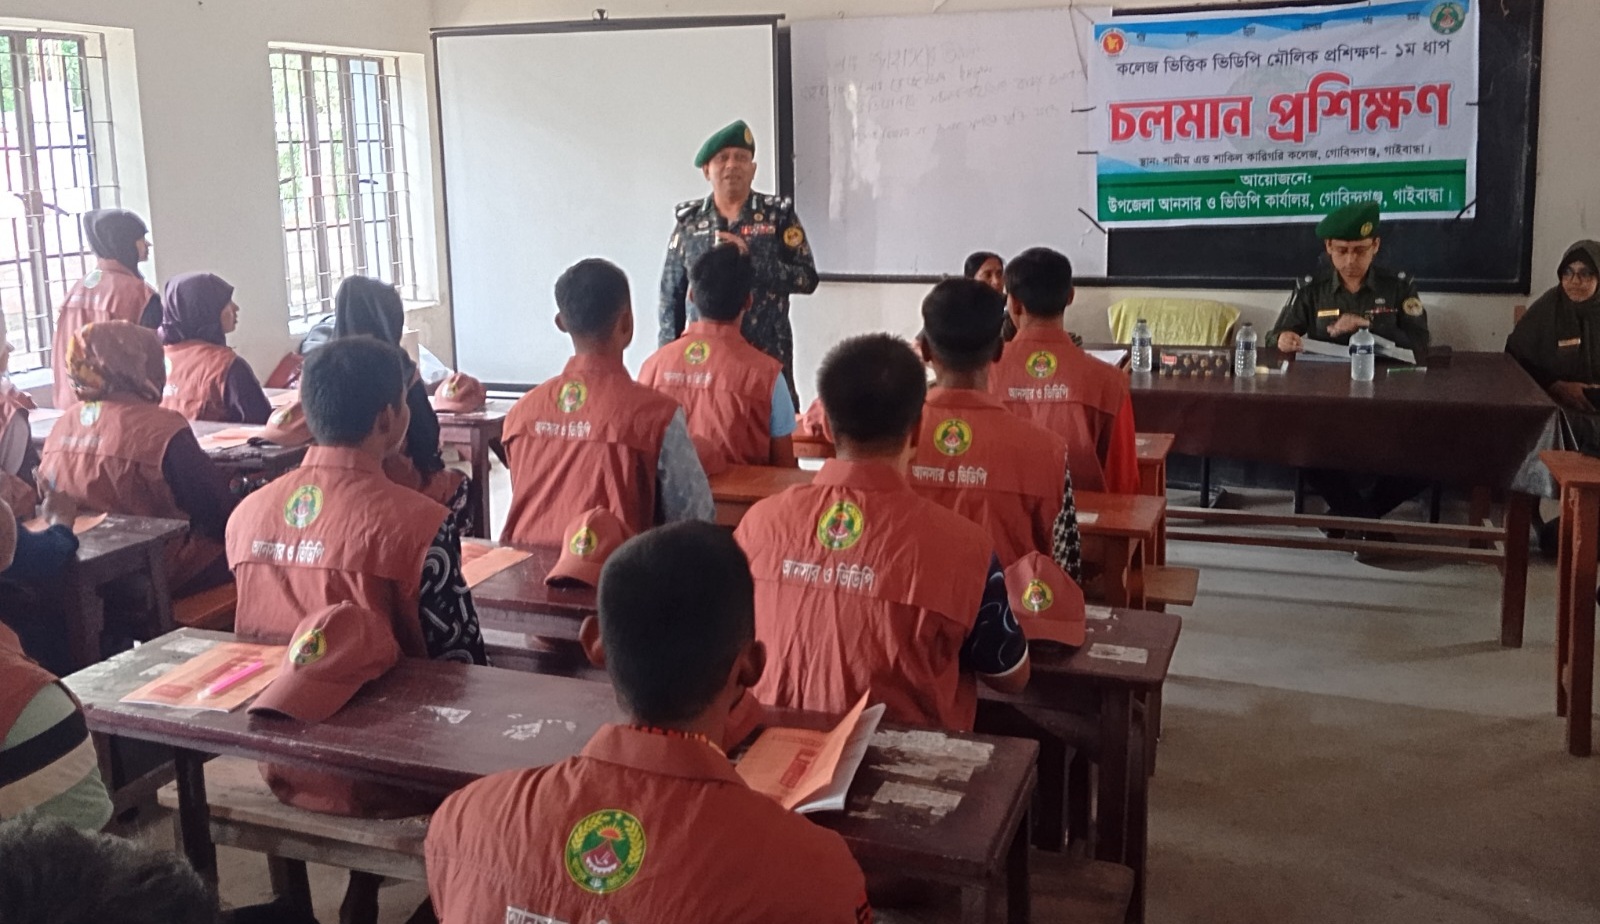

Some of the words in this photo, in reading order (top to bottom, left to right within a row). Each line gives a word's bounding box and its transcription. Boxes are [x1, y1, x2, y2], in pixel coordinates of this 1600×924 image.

[1116, 61, 1158, 76] কলেজ
[1164, 55, 1208, 73] ভিত্তিক
[1212, 51, 1261, 71] ভিডিপি
[1267, 47, 1319, 67] মৌলিক
[1395, 42, 1416, 58] ১ম
[1423, 39, 1451, 55] ধাপ
[1108, 95, 1254, 143] চলমান
[1268, 71, 1452, 143] প্রশিক্ষণ
[1163, 152, 1190, 165] শামীম
[1213, 151, 1243, 164] শাকিল
[1246, 149, 1284, 162] কারিগরি
[1287, 150, 1321, 160] কলেজ,
[1107, 195, 1155, 213] উপজেলা
[1158, 196, 1202, 212] আনসার
[1206, 196, 1216, 210] ও
[1220, 190, 1261, 210] ভিডিপি
[782, 559, 822, 583] আনসার
[823, 567, 832, 583] ও
[835, 562, 875, 591] ভিডিপি
